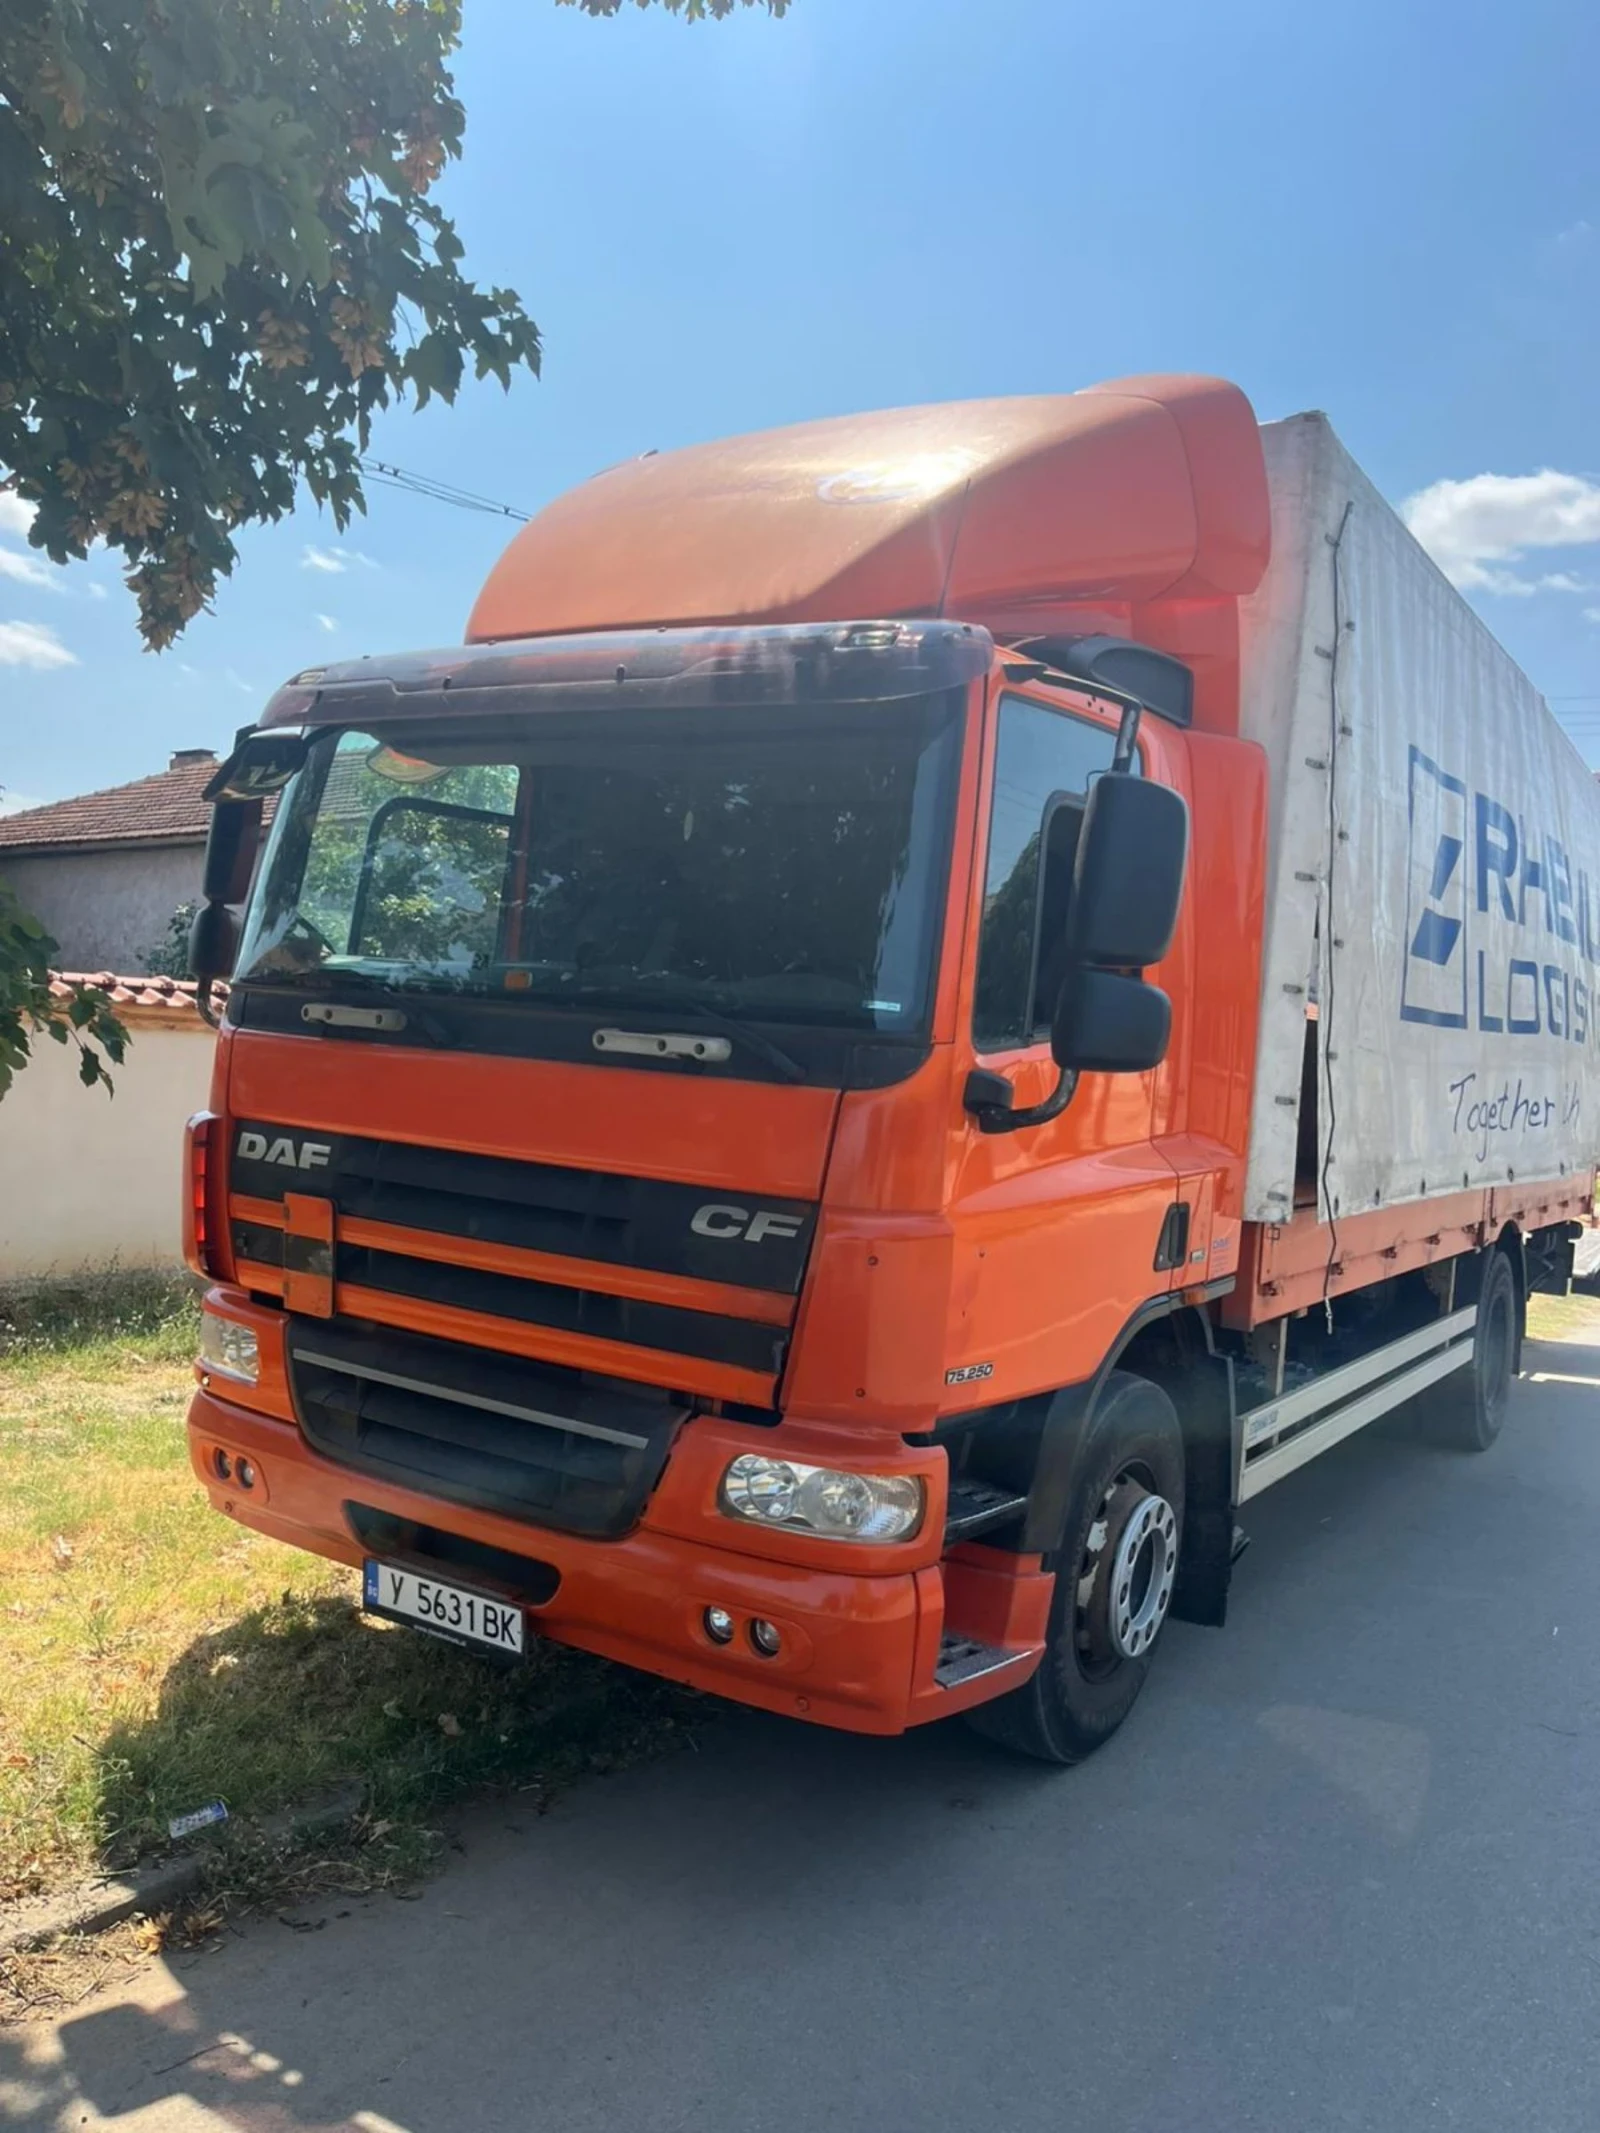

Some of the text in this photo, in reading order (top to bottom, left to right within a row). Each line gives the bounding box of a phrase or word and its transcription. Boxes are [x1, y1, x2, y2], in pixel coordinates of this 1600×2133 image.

[1450, 1073, 1555, 1162] Together
[237, 1131, 332, 1169] DAF
[690, 1204, 805, 1242] CF
[948, 1364, 993, 1383] 75.250
